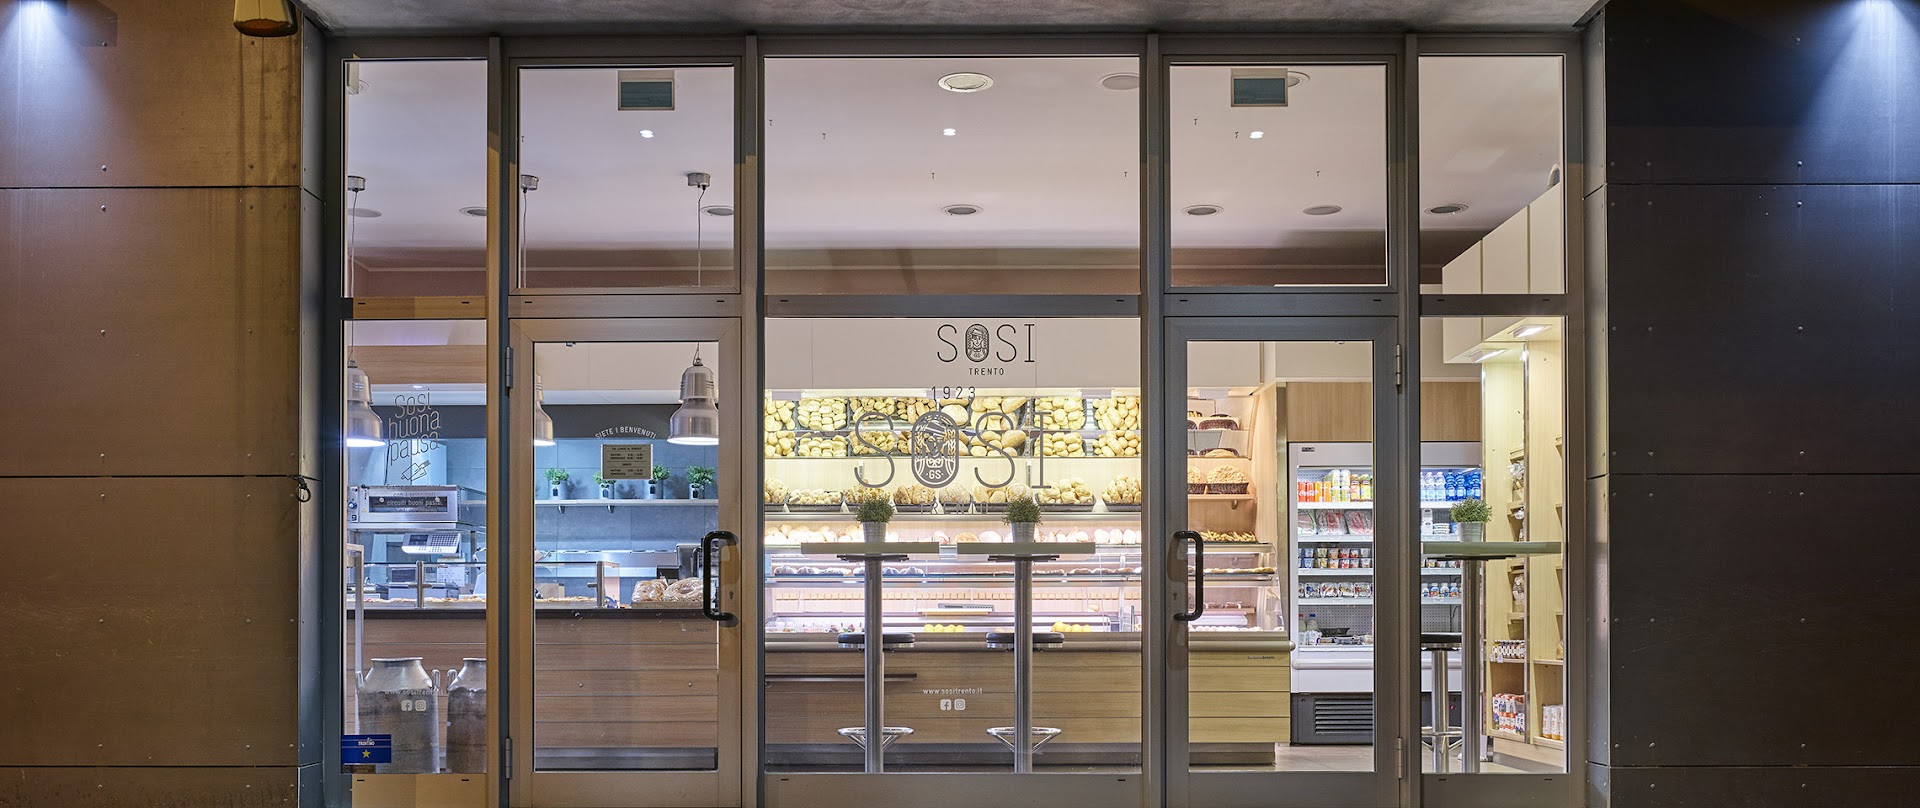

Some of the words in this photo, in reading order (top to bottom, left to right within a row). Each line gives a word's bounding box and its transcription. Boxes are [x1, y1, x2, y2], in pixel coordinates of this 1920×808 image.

[969, 367, 1005, 376] TRENTO
[931, 386, 976, 400] 1923
[395, 388, 432, 418] Sosi
[388, 410, 441, 440] buona
[594, 427, 614, 439] SIETE
[615, 426, 619, 434] I
[620, 426, 657, 439] BENVENUTI
[390, 431, 440, 466] pausa
[922, 687, 983, 695] www.sositrento.it
